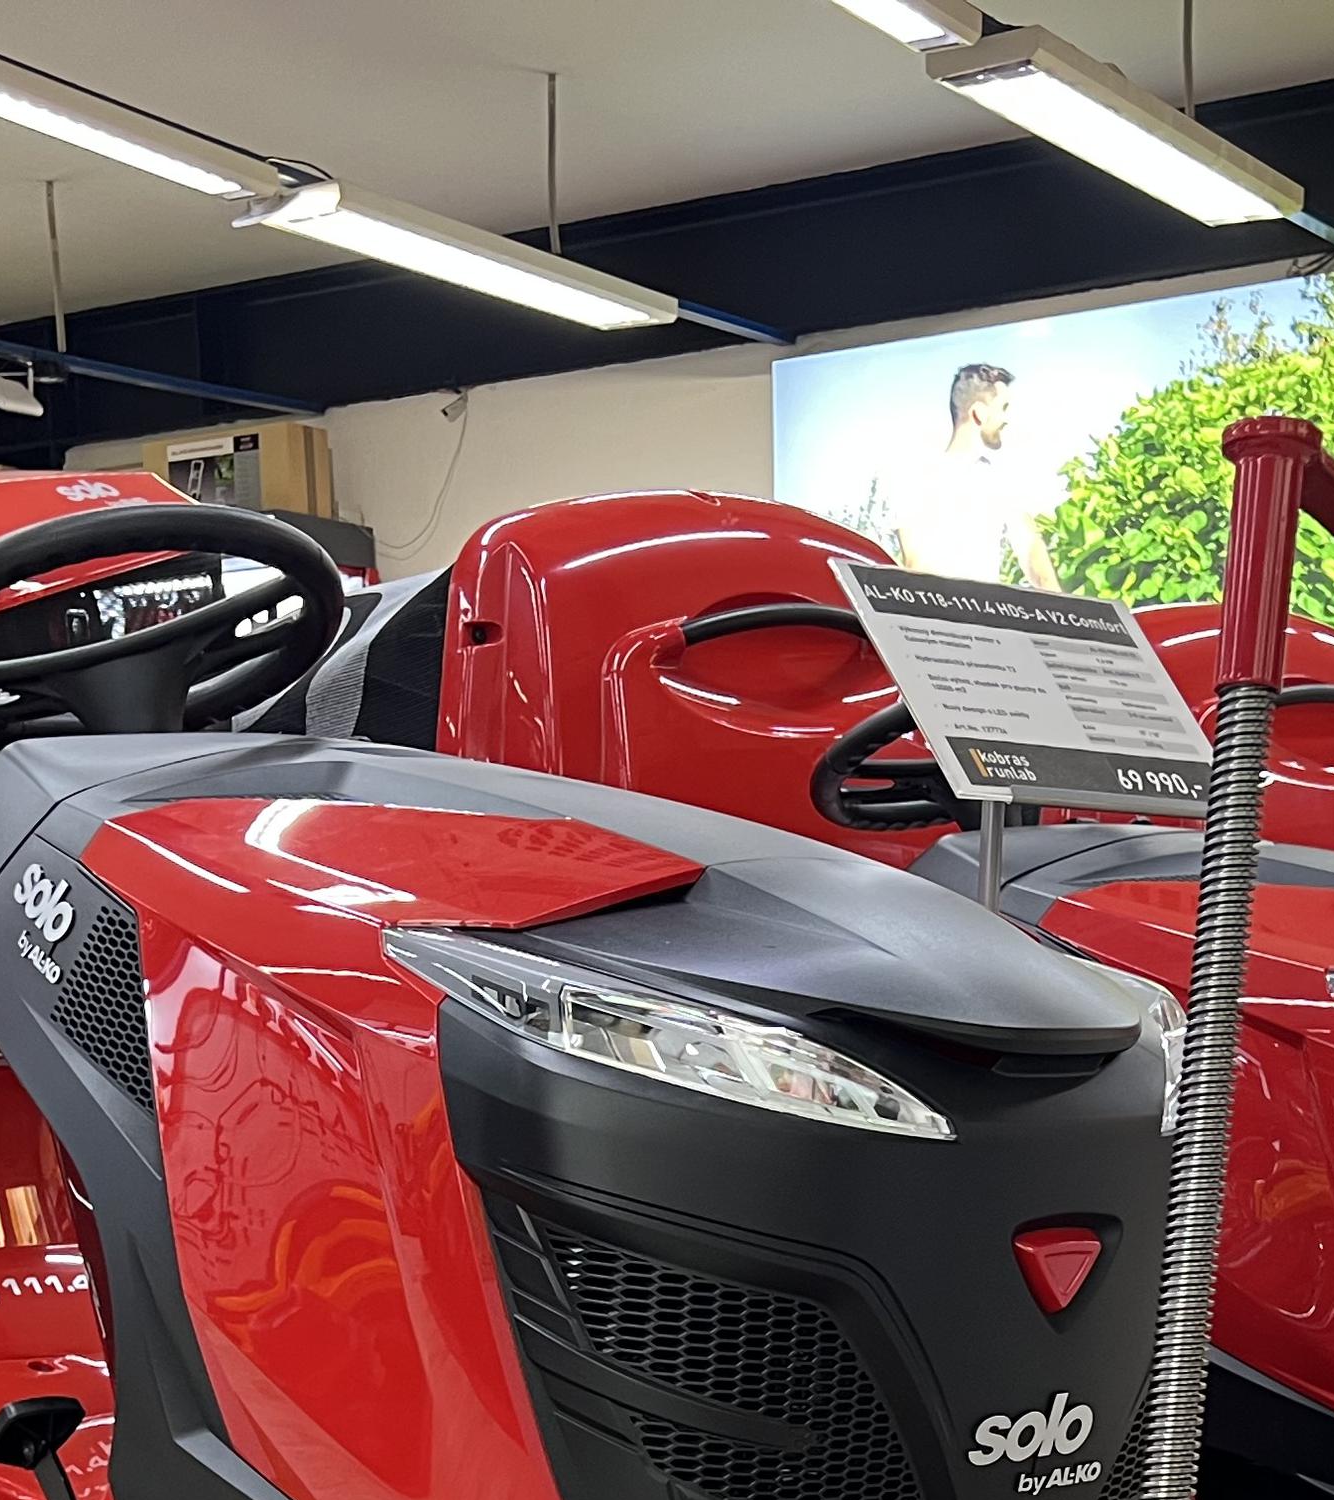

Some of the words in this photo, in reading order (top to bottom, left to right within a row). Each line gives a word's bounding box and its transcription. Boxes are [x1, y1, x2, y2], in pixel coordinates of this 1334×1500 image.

[865, 583, 915, 604] AL-KO
[916, 590, 996, 615] T18-111.4
[997, 601, 1048, 624] HDS-A
[1047, 608, 1069, 626] V2
[1068, 612, 1129, 635] Comfort
[976, 749, 1030, 767] kobras
[986, 765, 1037, 782] runlab
[1117, 768, 1143, 791] 69
[1146, 770, 1203, 799] 990,-
[14, 863, 74, 942] solo
[17, 930, 33, 958] by
[968, 1392, 1094, 1466] solo
[1017, 1473, 1047, 1496] by
[1045, 1461, 1103, 1488] AL-KO
